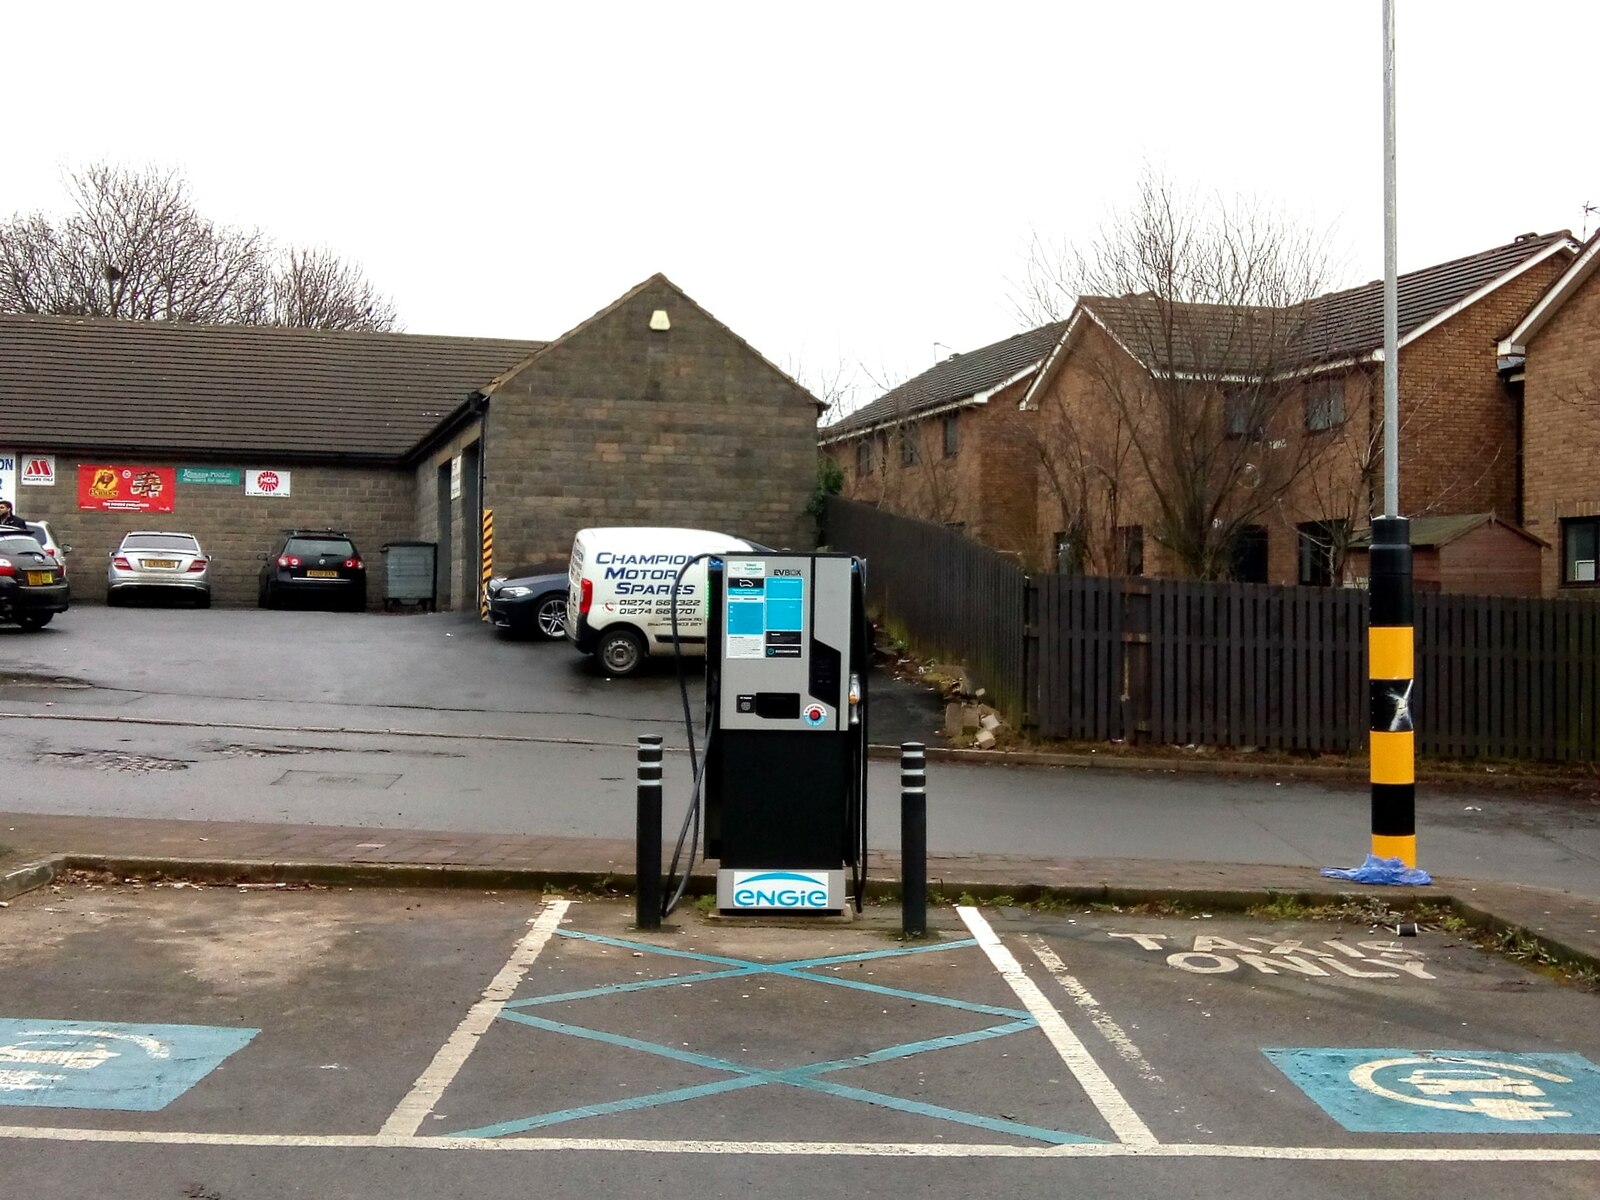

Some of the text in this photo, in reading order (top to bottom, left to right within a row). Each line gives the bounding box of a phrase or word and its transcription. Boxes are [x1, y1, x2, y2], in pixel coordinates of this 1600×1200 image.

[260, 476, 278, 484] NGK
[596, 552, 700, 565] CHAMPION
[604, 567, 678, 580] MOTOR
[773, 569, 802, 577] EVBOX
[1108, 932, 1425, 962] TAXIS
[1166, 951, 1437, 980] ONLY
